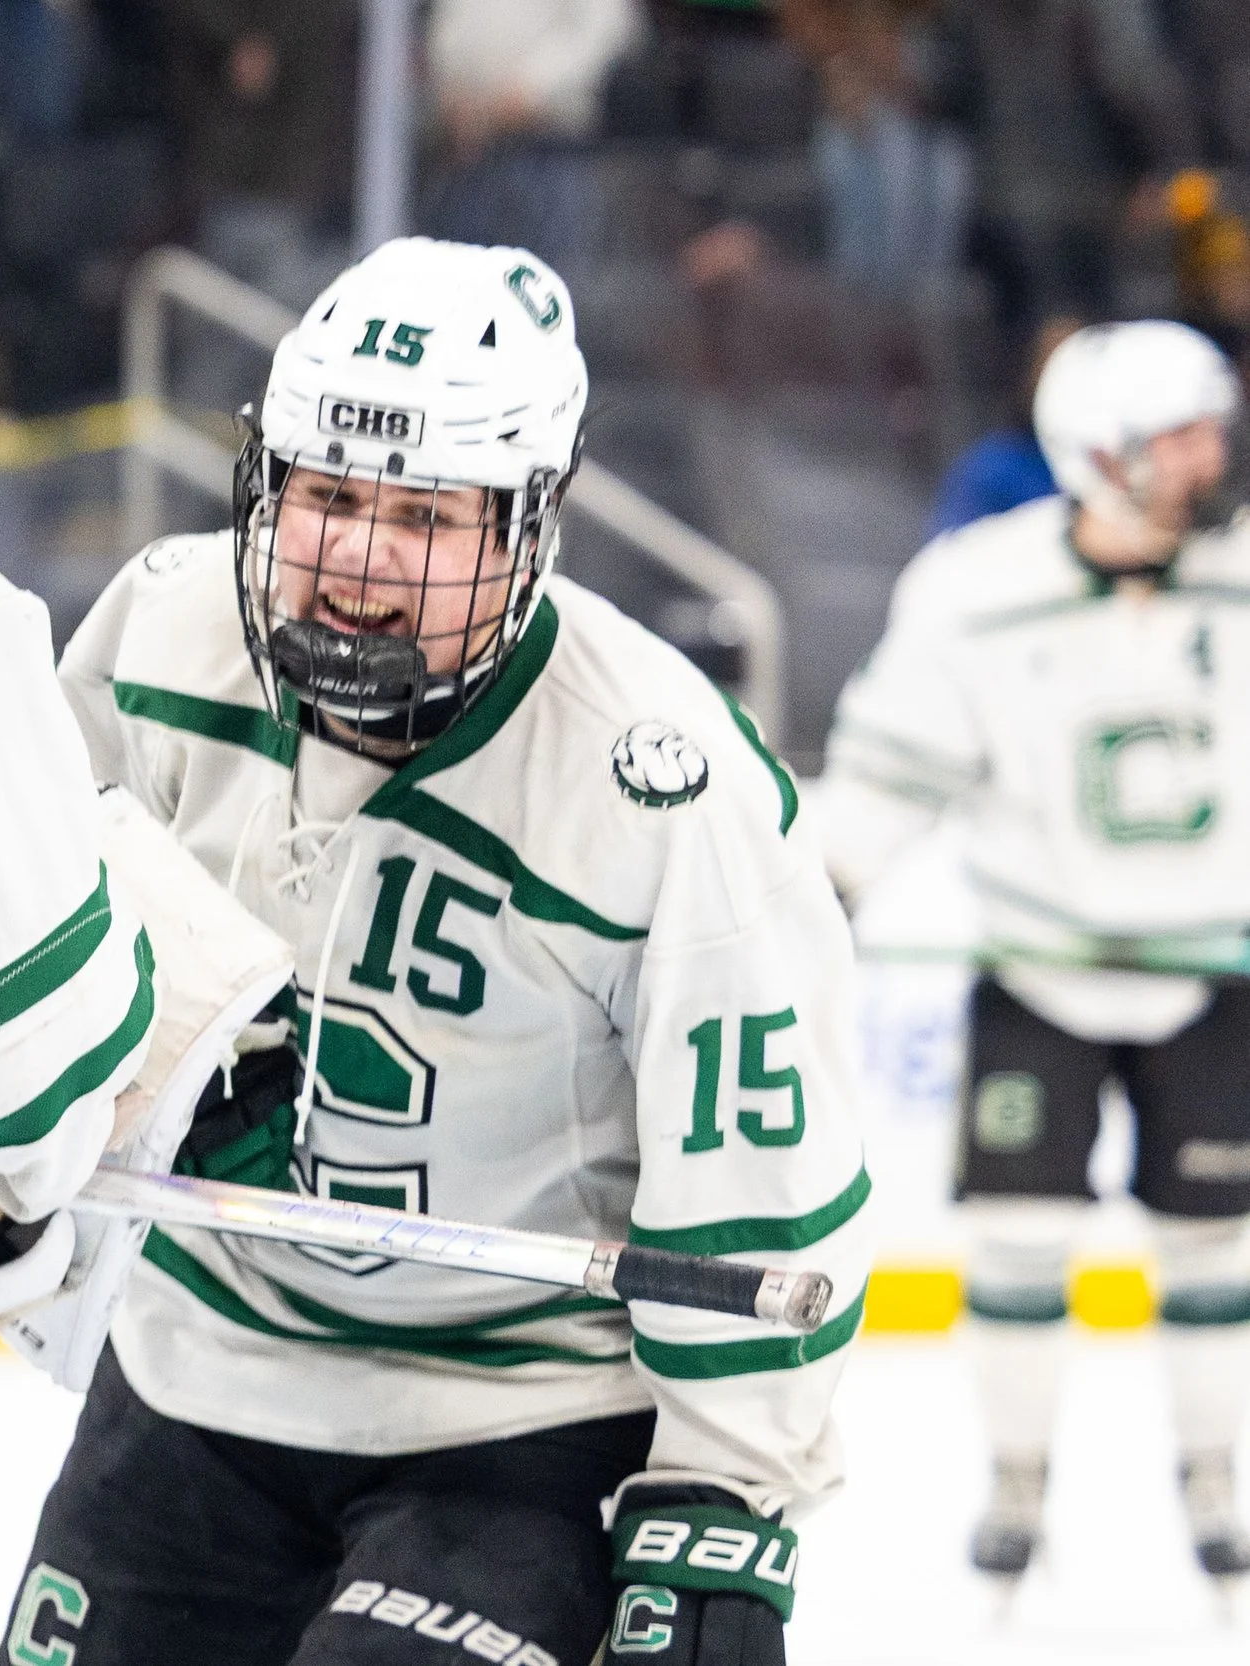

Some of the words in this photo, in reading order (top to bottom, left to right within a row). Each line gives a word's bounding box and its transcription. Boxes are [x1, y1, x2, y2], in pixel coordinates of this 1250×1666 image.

[352, 318, 434, 366] 15
[504, 264, 561, 333] C
[350, 854, 502, 1017] 15
[681, 1005, 806, 1154] 15
[8, 1561, 90, 1666] C
[610, 1585, 678, 1653] C
